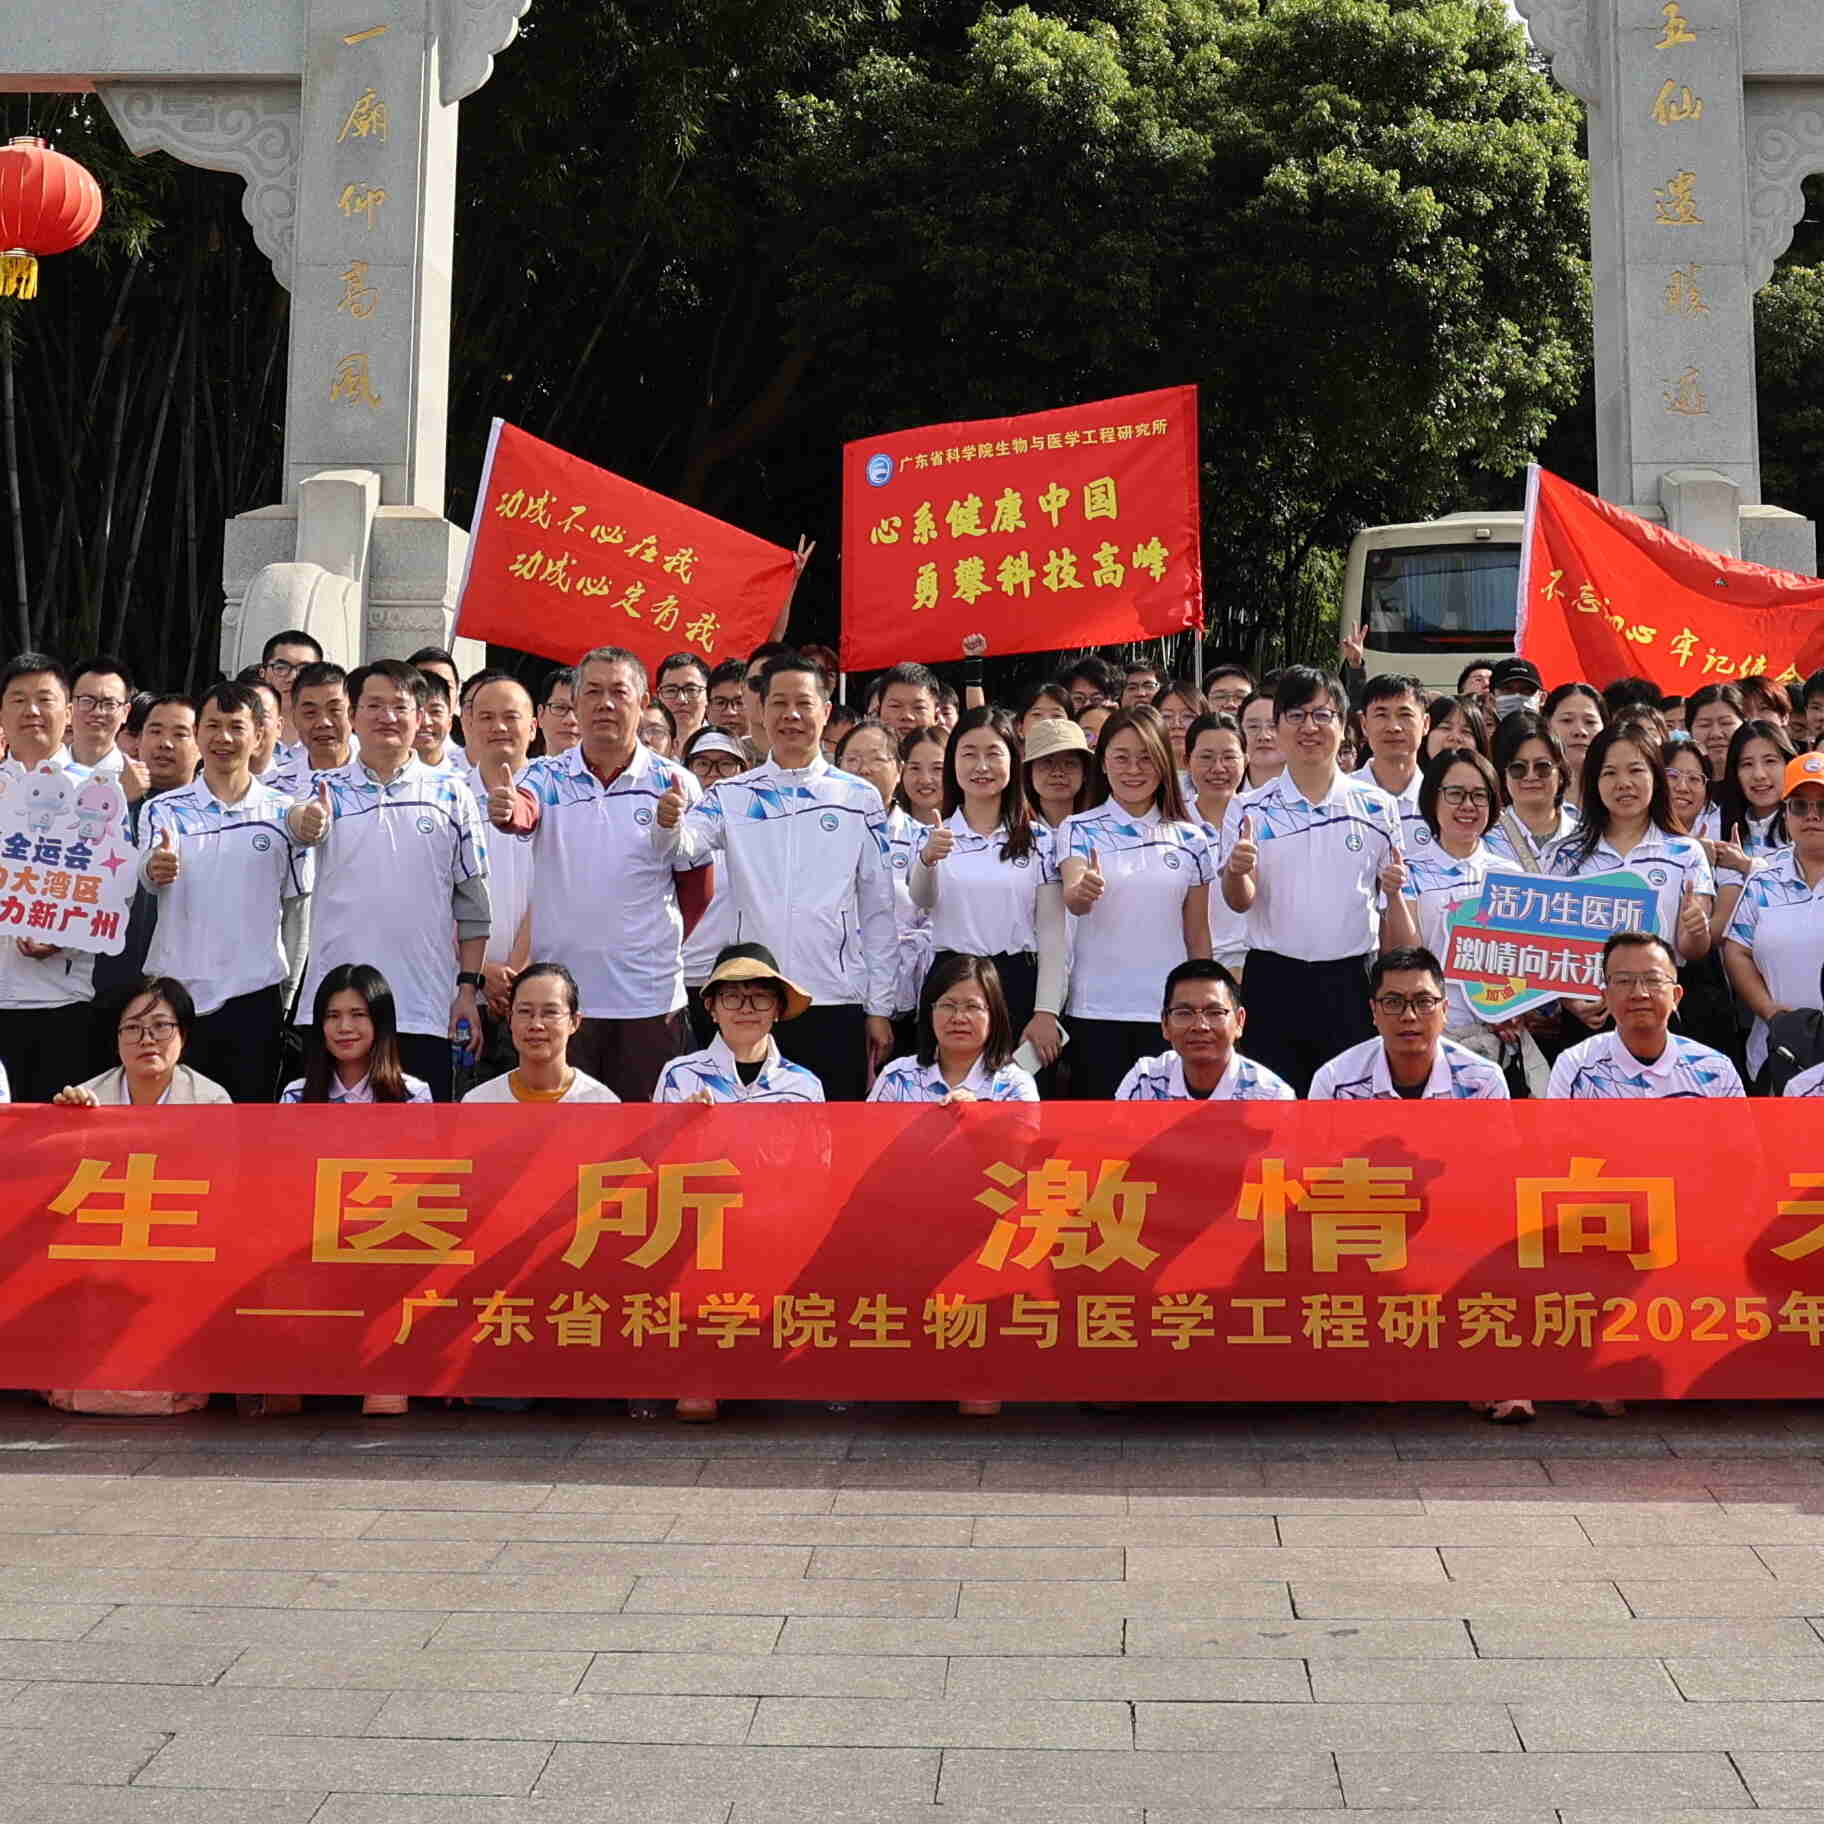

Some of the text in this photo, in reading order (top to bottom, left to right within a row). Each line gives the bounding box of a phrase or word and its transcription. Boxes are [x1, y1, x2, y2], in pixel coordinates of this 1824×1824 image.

[899, 418, 1169, 473] 广东省科学院生物与医学工程研究所
[495, 489, 699, 584] 功成不必在我
[870, 476, 1119, 544] 心系健康中国
[509, 550, 721, 653] 功成必定有我
[911, 537, 1170, 610] 勇攀科技高峰
[1487, 883, 1644, 932] 活力生医所
[1453, 936, 1606, 990] 激情向未来
